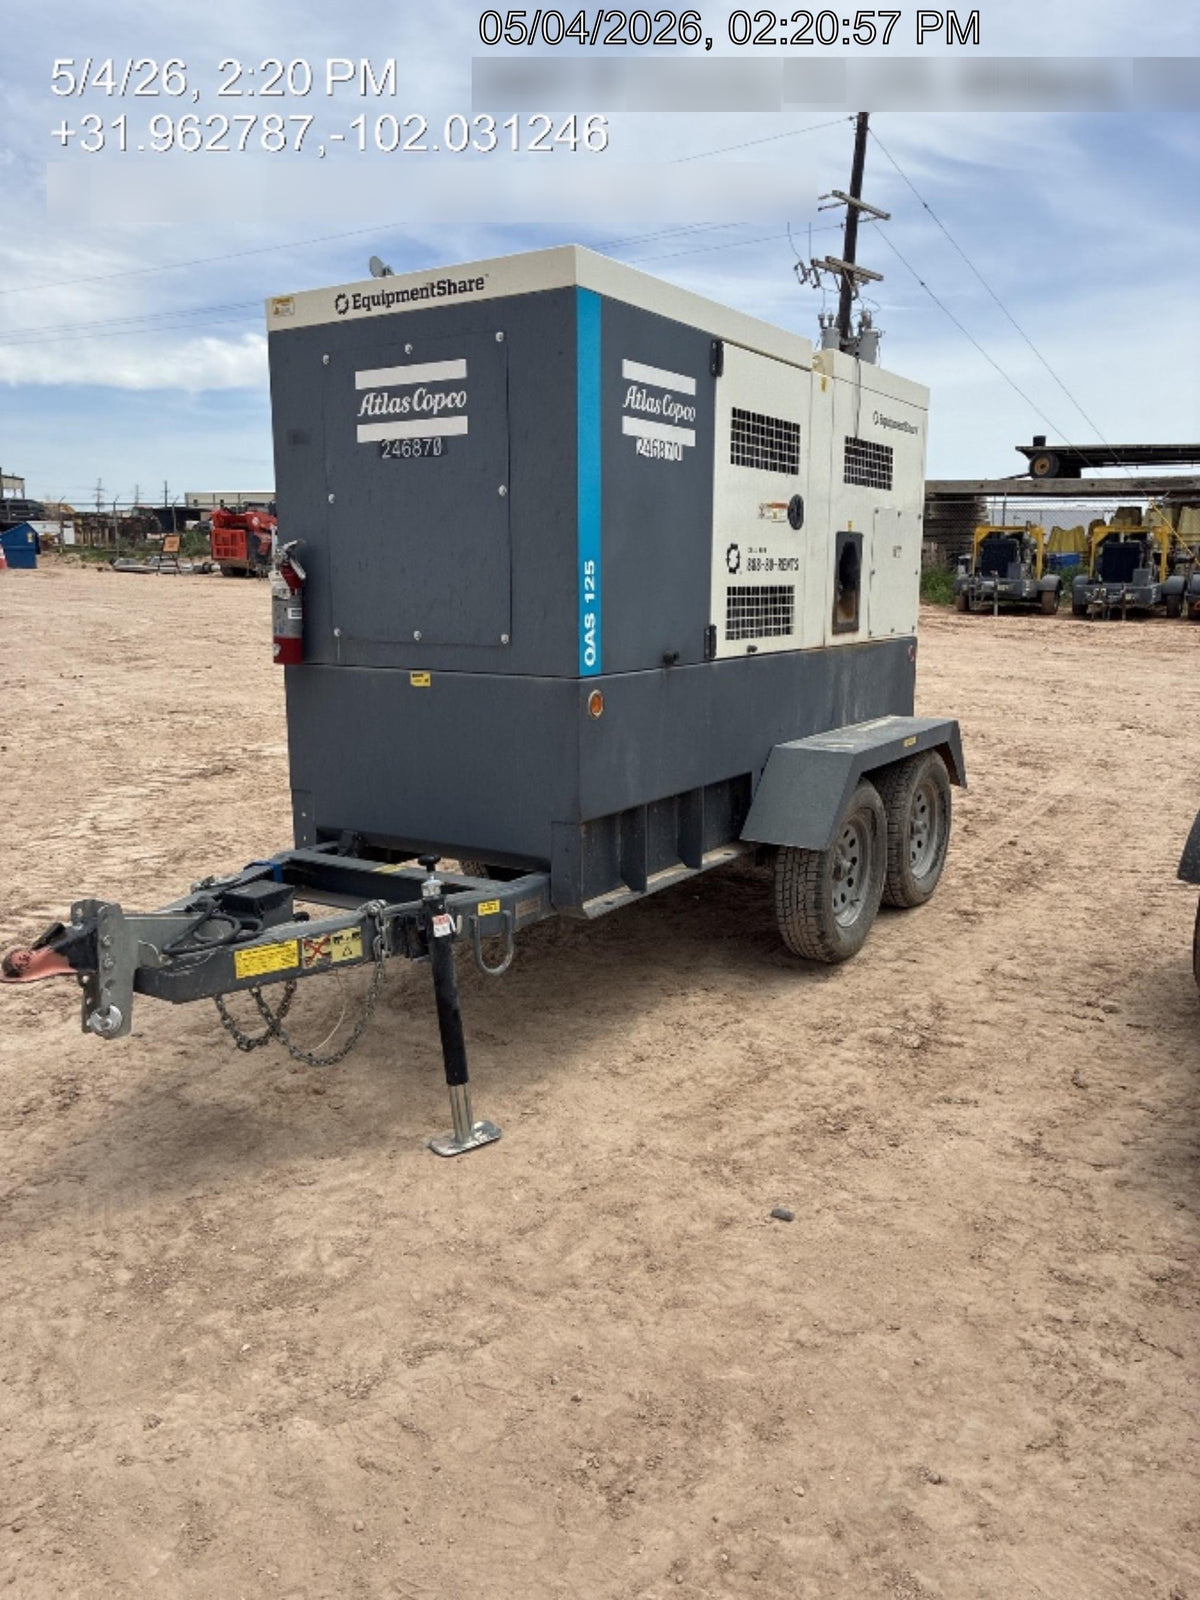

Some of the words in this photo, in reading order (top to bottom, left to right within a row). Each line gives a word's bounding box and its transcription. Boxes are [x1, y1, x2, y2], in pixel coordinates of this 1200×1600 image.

[352, 277, 485, 312] EquipmentShare
[357, 392, 411, 417] Atlas
[413, 387, 467, 415] Copco
[622, 385, 661, 415] Atlas
[662, 394, 696, 424] Copco
[381, 437, 442, 459] 246870
[583, 559, 595, 604] 125
